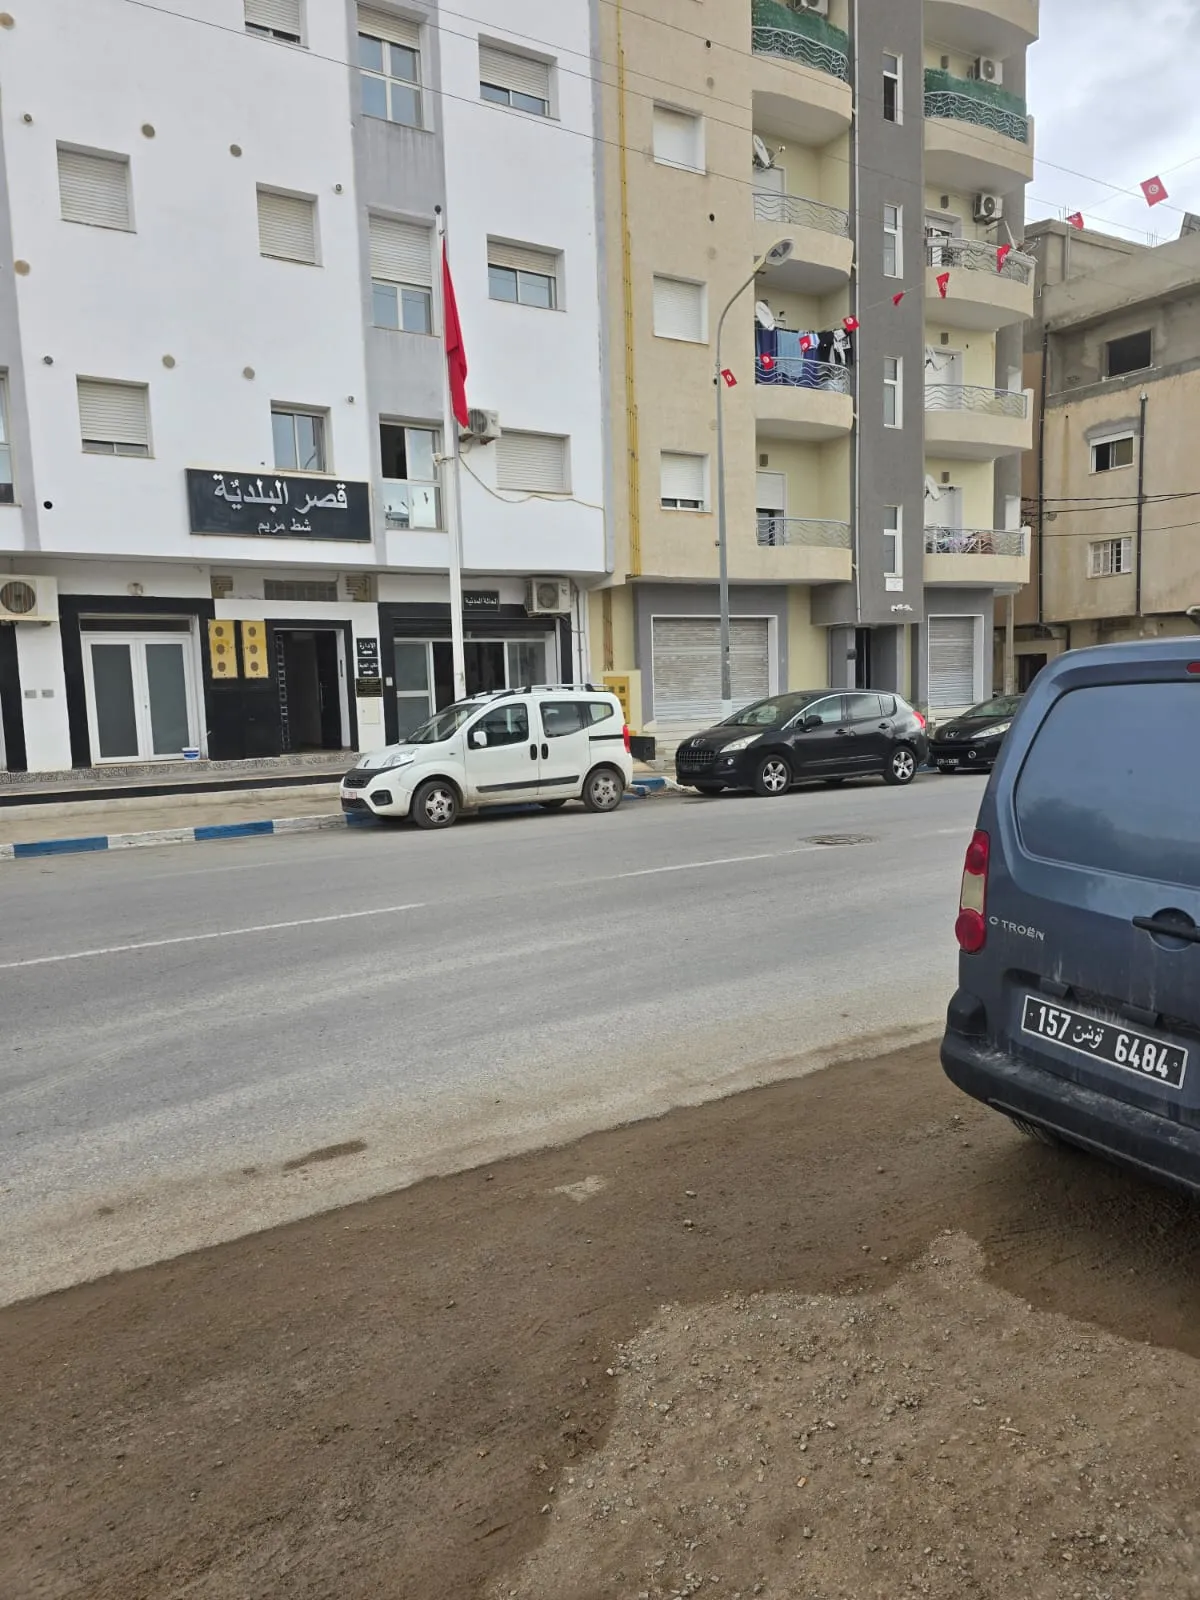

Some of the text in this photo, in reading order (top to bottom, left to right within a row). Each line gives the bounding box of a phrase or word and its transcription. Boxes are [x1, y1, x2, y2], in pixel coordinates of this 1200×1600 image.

[294, 483, 348, 514] قصر
[257, 518, 312, 535] شط مريم
[1038, 1006, 1071, 1040] 157
[1114, 1034, 1169, 1078] 6484
